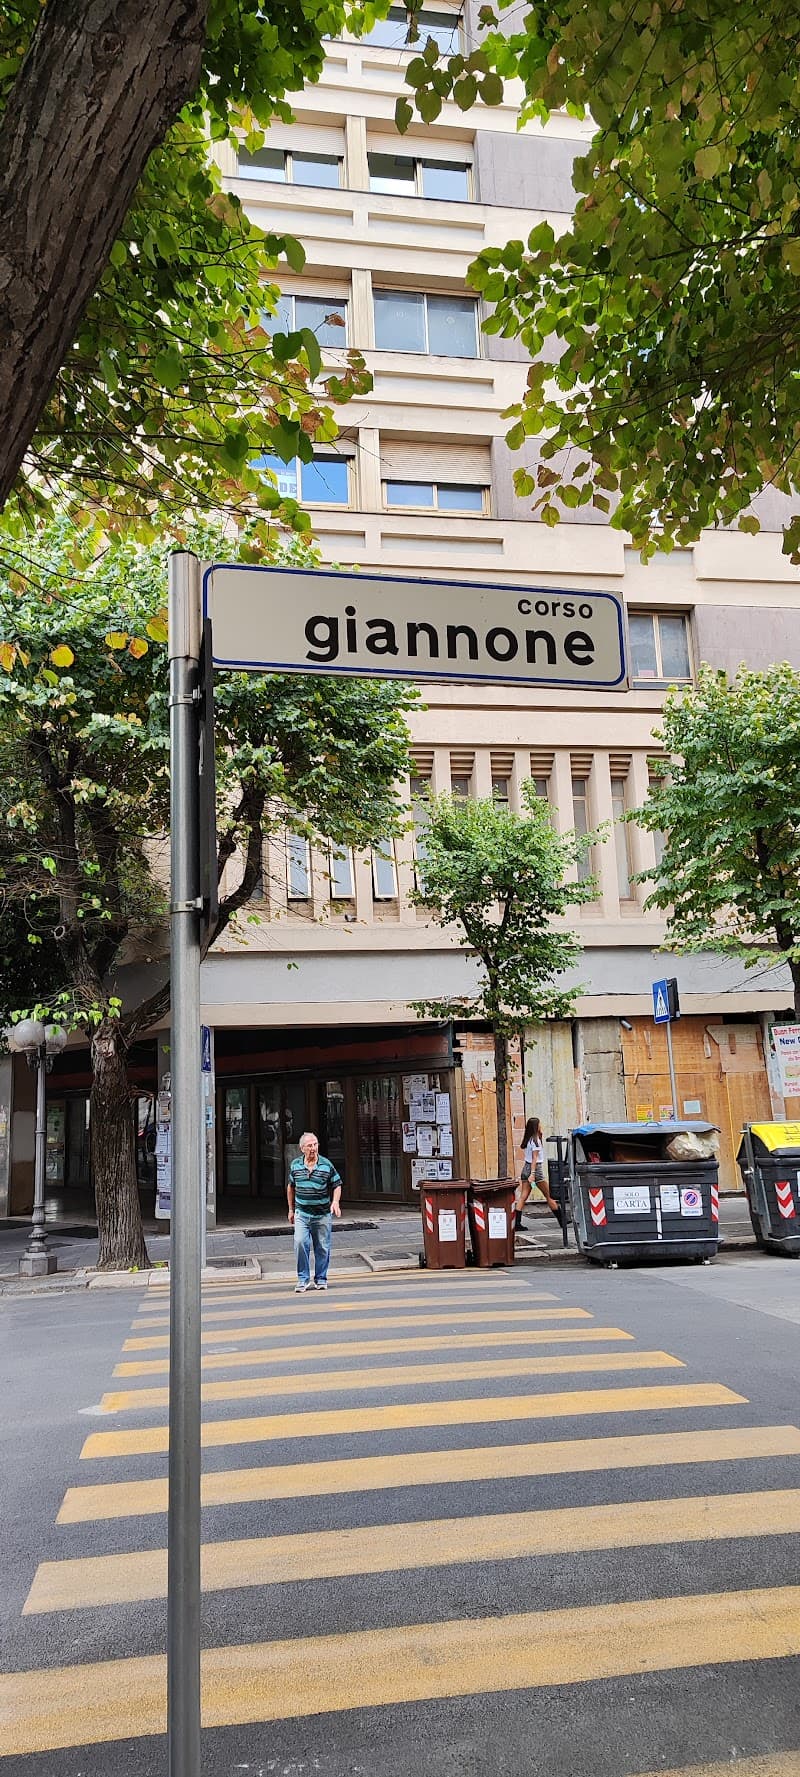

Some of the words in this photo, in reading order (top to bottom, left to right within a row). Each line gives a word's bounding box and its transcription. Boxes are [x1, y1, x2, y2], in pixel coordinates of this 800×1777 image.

[517, 599, 593, 619] corso
[304, 605, 595, 666] giannone
[779, 1037, 795, 1045] New
[616, 1200, 648, 1208] CARTA
